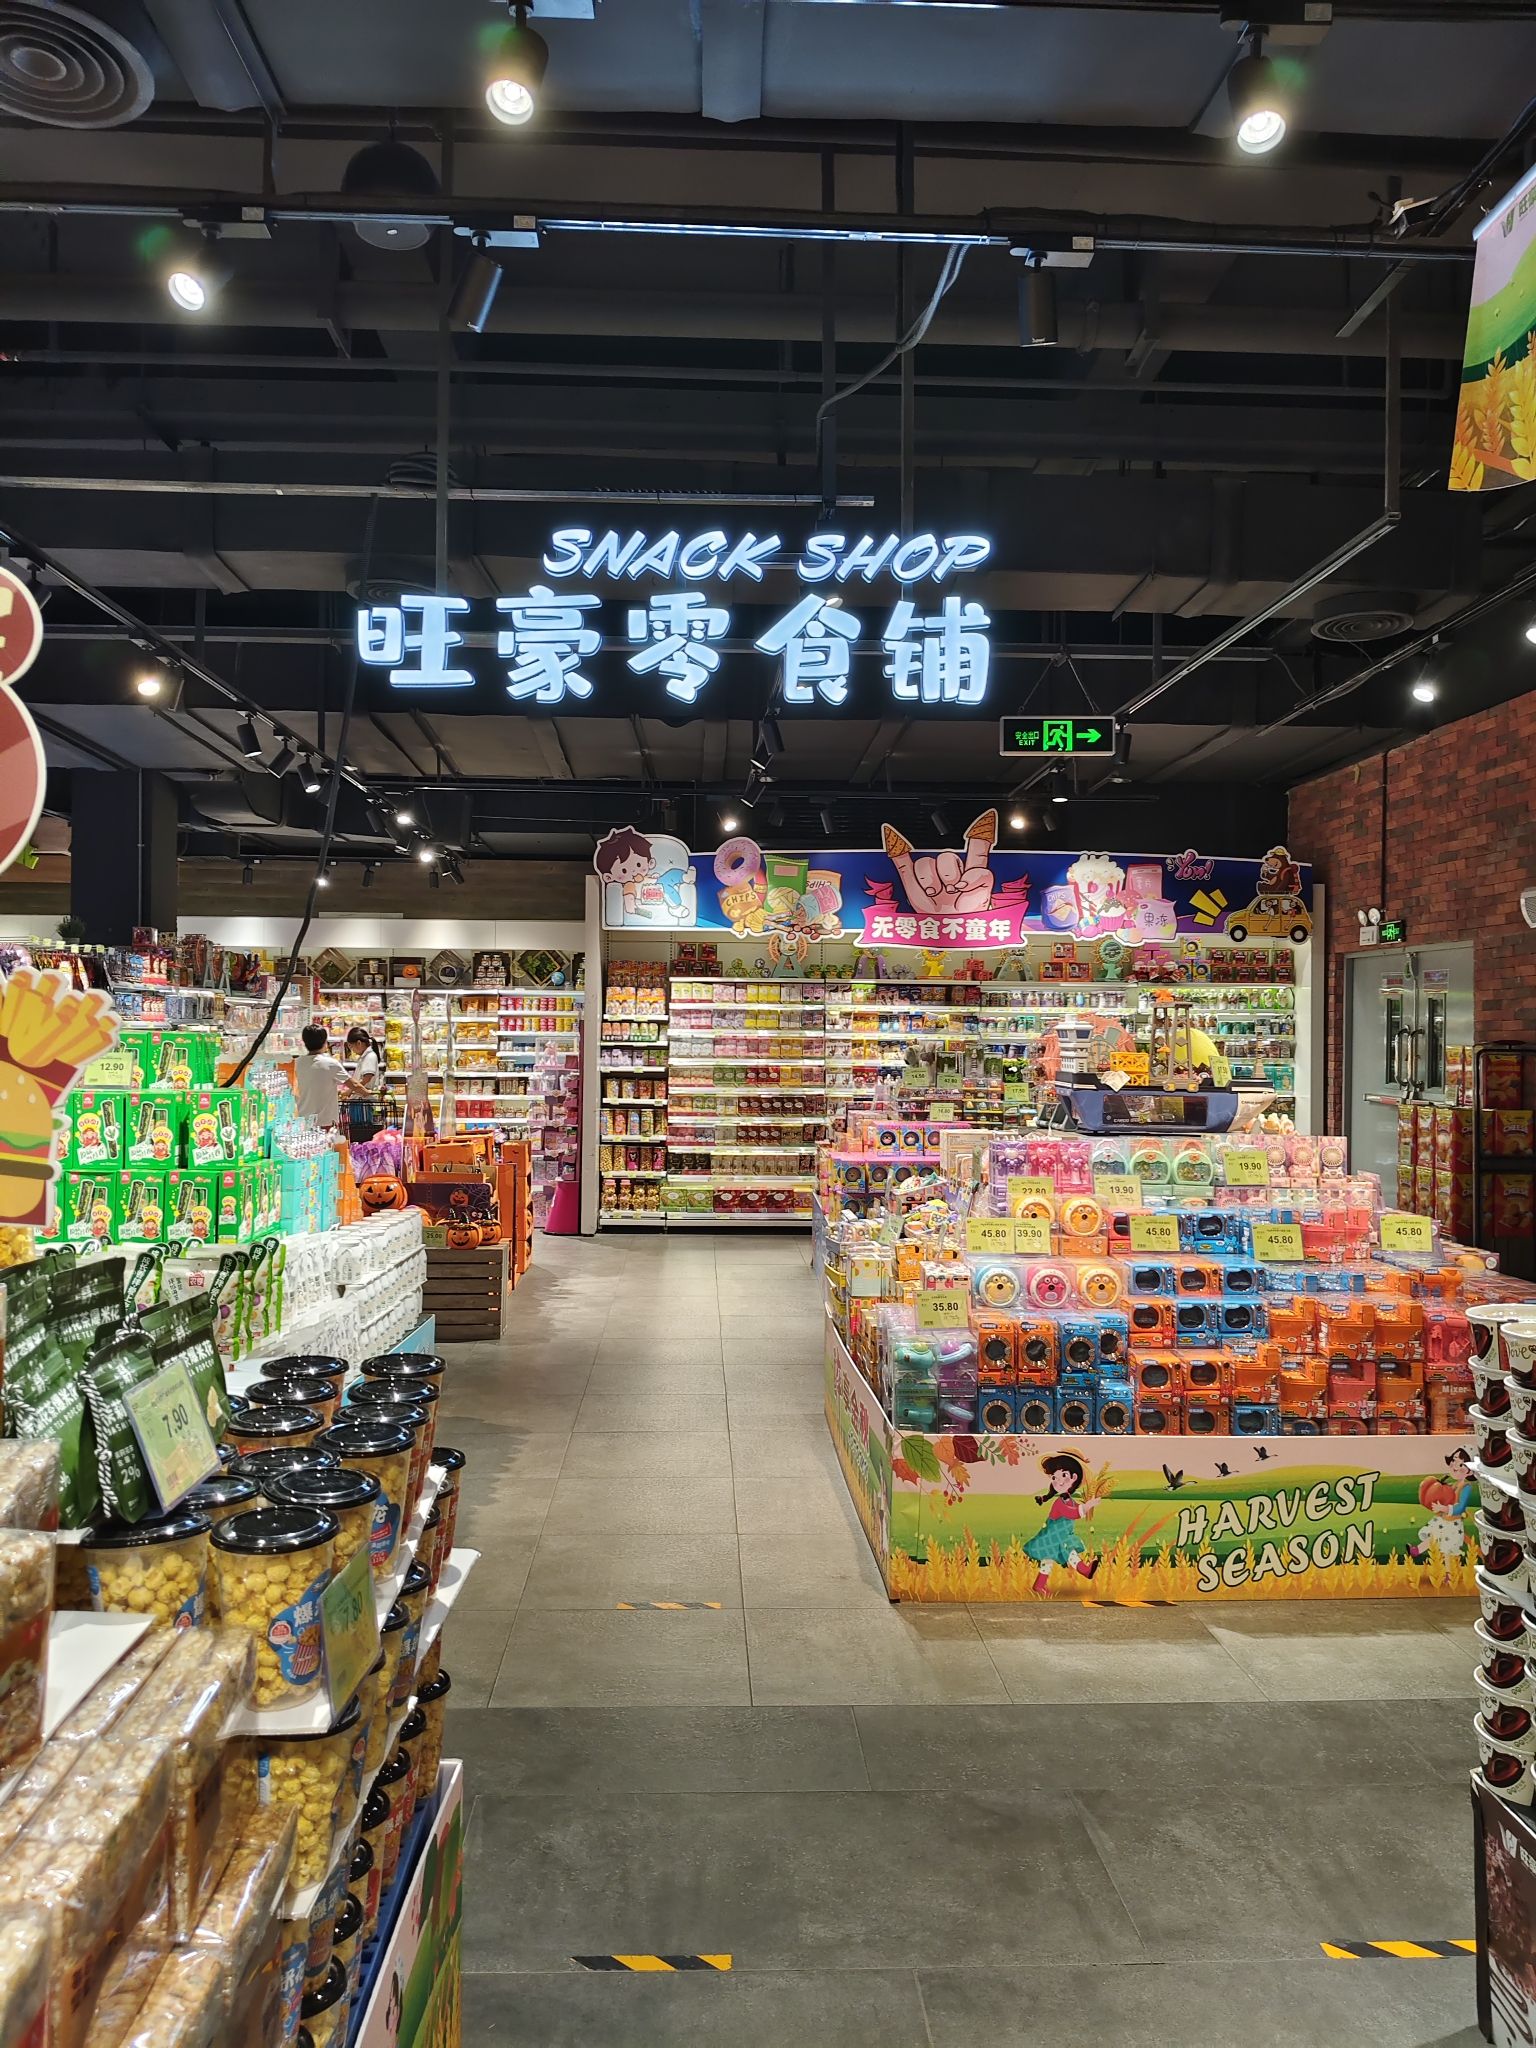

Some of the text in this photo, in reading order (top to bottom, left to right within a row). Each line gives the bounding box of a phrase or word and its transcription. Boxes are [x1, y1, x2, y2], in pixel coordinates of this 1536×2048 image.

[543, 528, 991, 583] SNACK SHOP
[357, 585, 992, 706] 旺豪零食铺
[1015, 731, 1040, 740] 安全出口
[725, 891, 758, 907] CHIPS
[1144, 912, 1168, 928] 果冻
[871, 915, 1011, 941] 无零食不童年
[100, 1062, 124, 1072] 12.90
[1239, 1161, 1262, 1171] 19.90
[1109, 1186, 1134, 1195] 19.90
[981, 1229, 1007, 1238] 45.80
[1017, 1229, 1042, 1238] 39.90
[1145, 1227, 1171, 1237] 45.80
[1395, 1227, 1422, 1237] 45.80
[1267, 1235, 1294, 1245] 45.80
[932, 1301, 959, 1312] 35.80
[1442, 1385, 1468, 1394] Mixer
[162, 1404, 190, 1438] 7.90
[120, 1462, 141, 1486] 2%
[1176, 1471, 1381, 1548] HARVEST
[1196, 1520, 1374, 1592] SEASON
